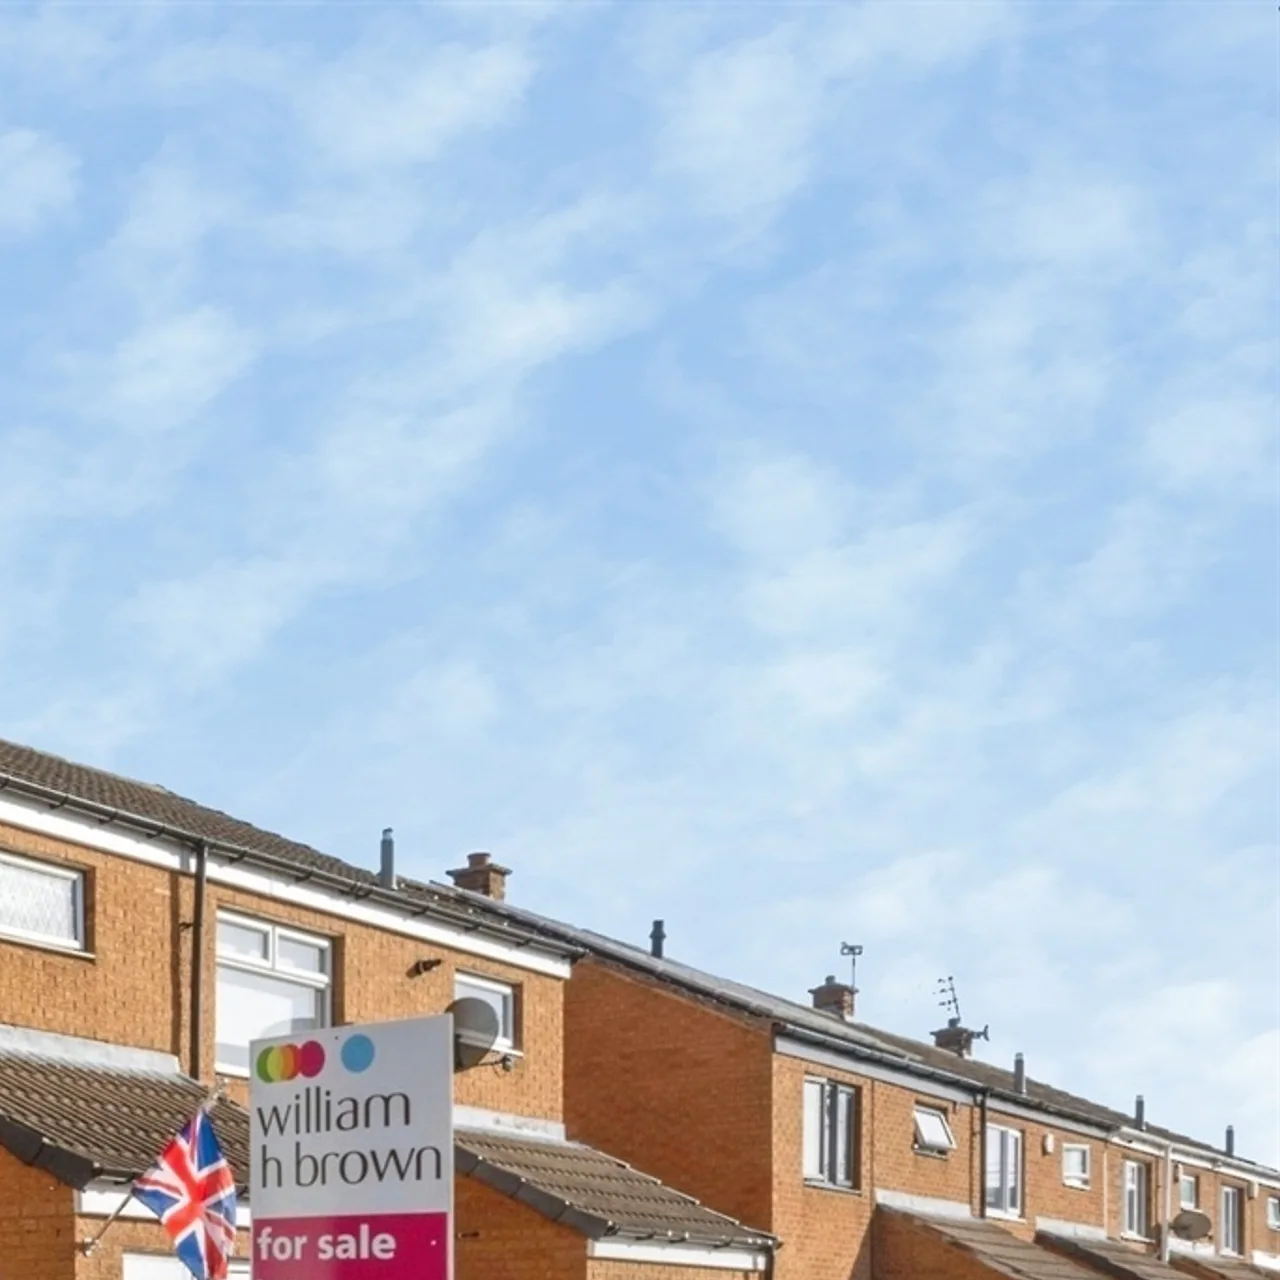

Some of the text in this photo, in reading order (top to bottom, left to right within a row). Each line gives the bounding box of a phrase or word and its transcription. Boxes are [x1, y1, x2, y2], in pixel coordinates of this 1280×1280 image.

[256, 1086, 411, 1137] william
[261, 1142, 442, 1188] h brown
[257, 1224, 397, 1261] for sale
